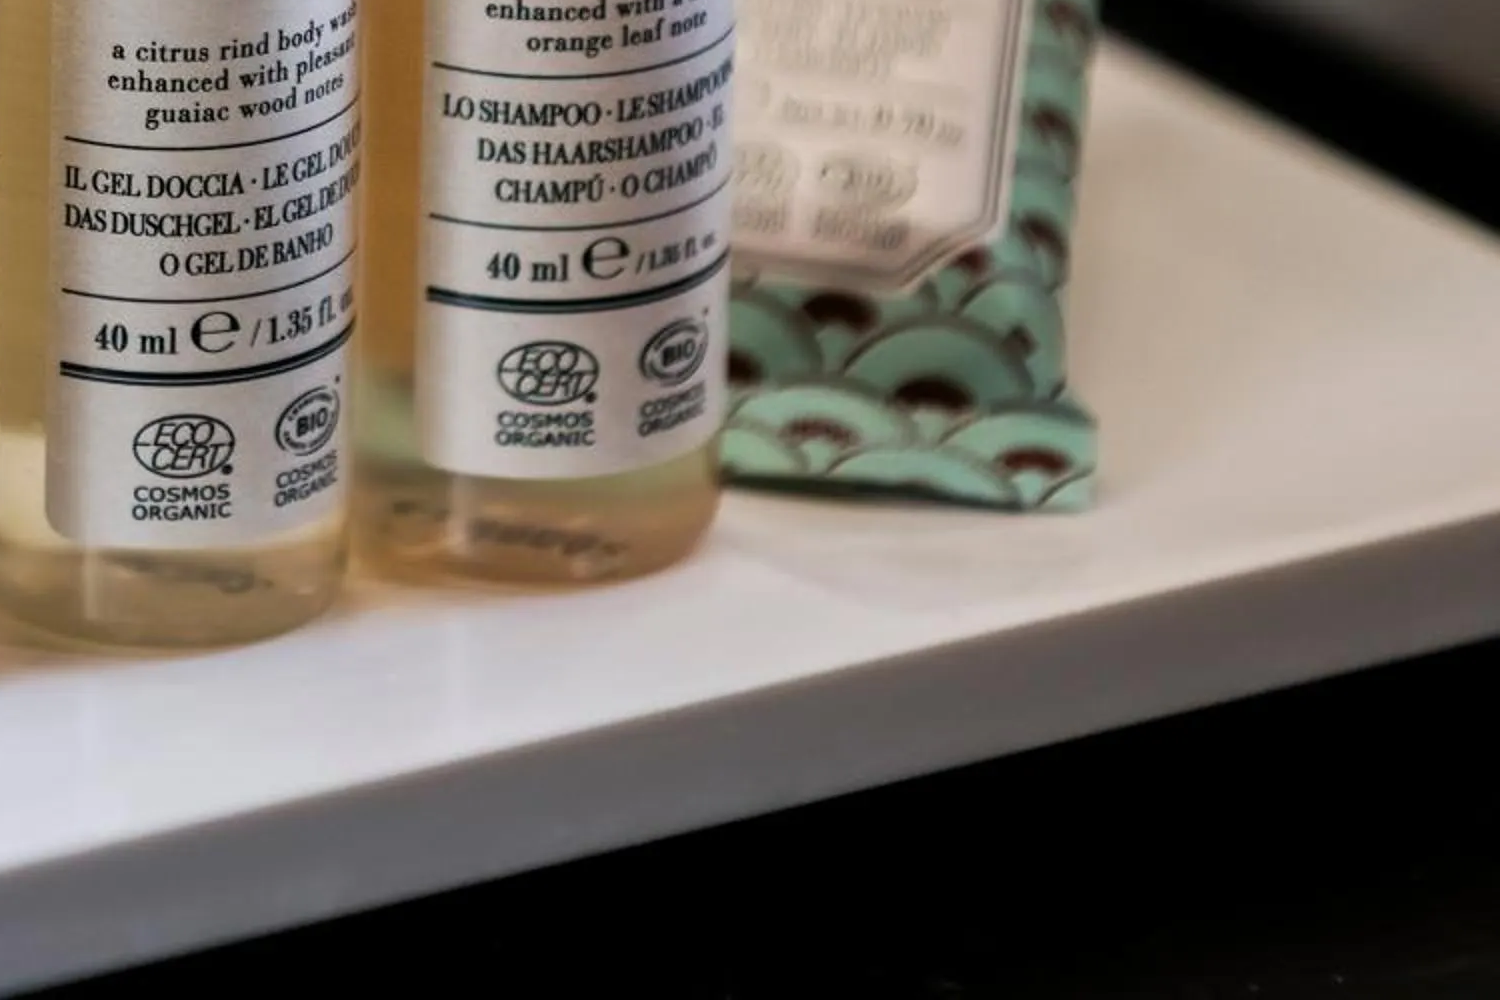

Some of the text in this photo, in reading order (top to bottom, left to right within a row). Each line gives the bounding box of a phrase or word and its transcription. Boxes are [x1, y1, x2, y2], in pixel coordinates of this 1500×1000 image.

[112, 44, 125, 60] a
[135, 42, 209, 63] citrus
[219, 32, 269, 61] rind
[277, 19, 324, 51] body
[527, 10, 707, 58] orange leaf note
[107, 69, 230, 93] enhanced
[238, 59, 289, 90] with
[145, 73, 344, 130] guaiac wood notes
[443, 93, 474, 120] LO
[479, 99, 601, 127] SHAMPOO
[477, 137, 527, 163] DAS
[532, 116, 701, 166] HAARSHAMPOO
[65, 165, 87, 191] IL
[91, 170, 141, 197] GEL
[147, 171, 245, 199] DOCCIA
[262, 162, 289, 190] LE
[291, 150, 327, 182] GEL
[621, 173, 640, 197] O
[64, 203, 107, 232] DAS
[111, 208, 241, 238] DUSCHGEL
[253, 204, 280, 231] EL
[282, 193, 318, 224] GEL
[159, 223, 333, 276] O GEL DE BANHO
[486, 252, 520, 280] 40
[531, 254, 569, 282] ml
[94, 324, 129, 352] 40
[138, 326, 179, 355] ml
[518, 348, 578, 374] ECO
[154, 422, 215, 446] ECO
[297, 407, 328, 437] BIO
[496, 411, 594, 429] COSMOS
[494, 429, 596, 448] ORGANIC
[152, 444, 224, 471] CERT
[133, 484, 231, 503] COSMOS
[132, 501, 232, 521] ORGANIC
